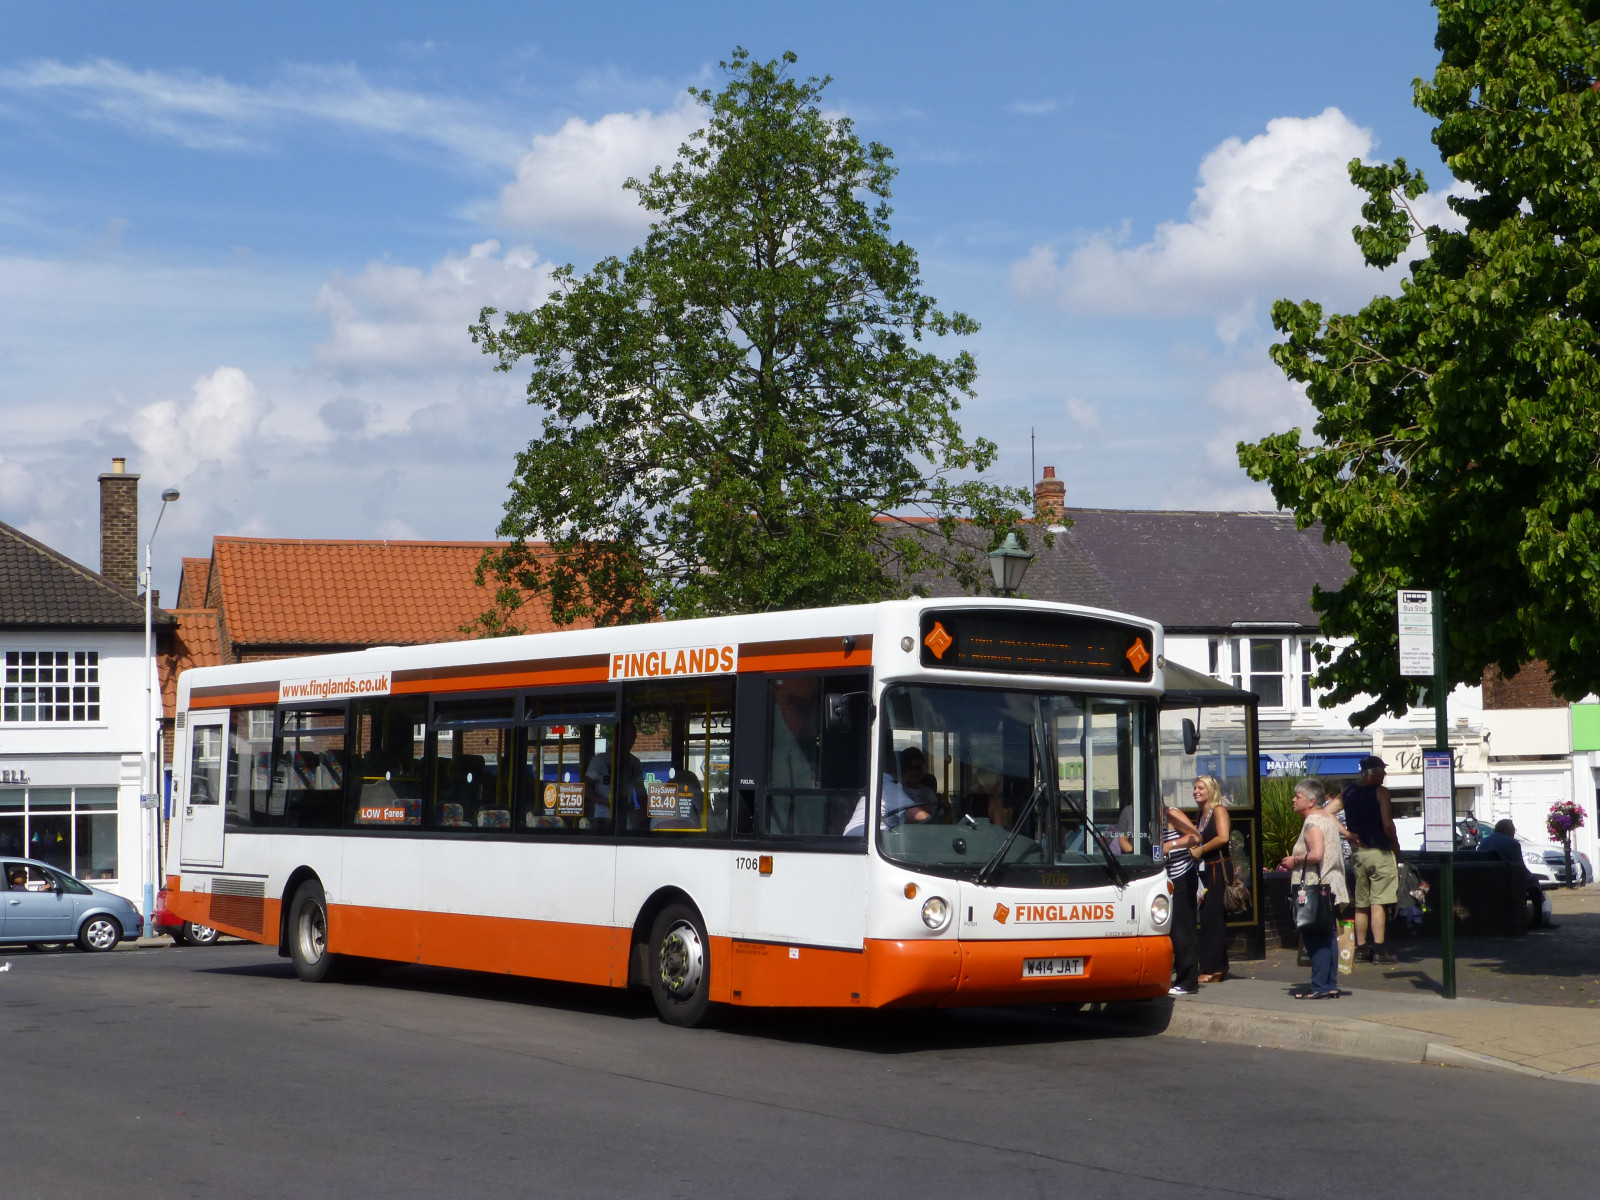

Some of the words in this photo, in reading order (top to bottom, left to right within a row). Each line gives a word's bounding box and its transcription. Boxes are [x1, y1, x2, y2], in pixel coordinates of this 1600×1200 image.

[1415, 605, 1427, 613] Stop
[612, 646, 734, 678] FINGLANDS
[282, 674, 388, 698] www.finglands.co.uk
[560, 794, 583, 806] £7.50
[650, 796, 676, 808] £3.40
[361, 808, 381, 818] LOW
[384, 808, 404, 820] Fares
[1126, 831, 1148, 839] FLOR
[735, 857, 758, 871] 1706
[1040, 873, 1069, 886] 1706
[1015, 904, 1114, 922] FINGLANDS
[1027, 960, 1054, 975] W414
[1056, 960, 1080, 974] JAT
